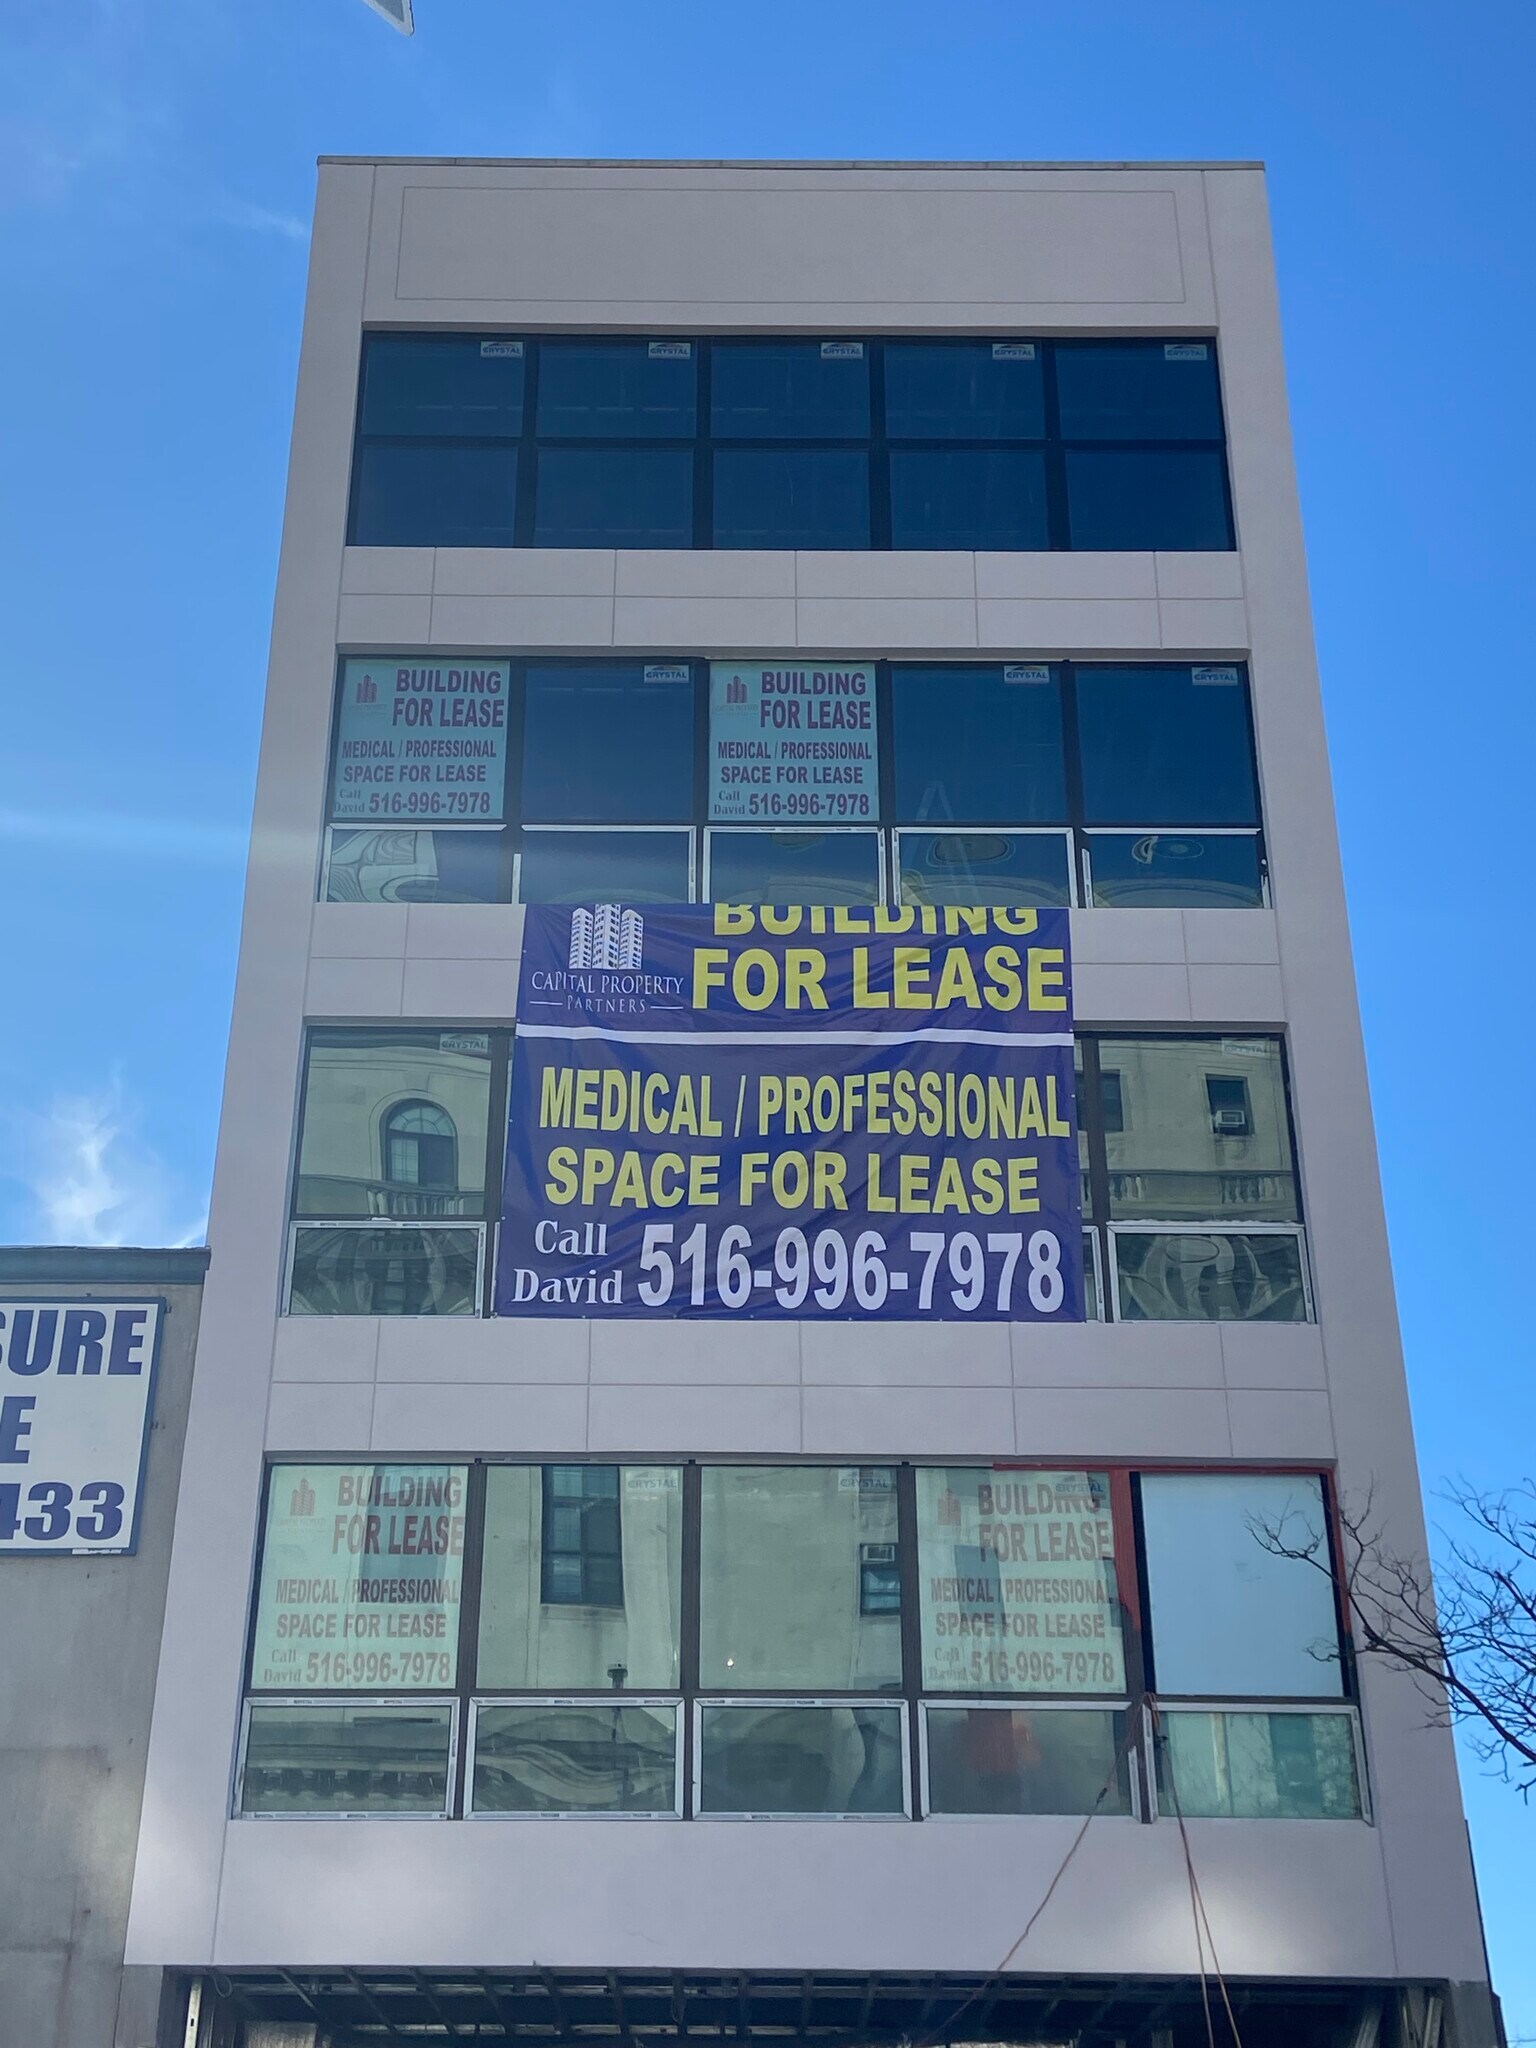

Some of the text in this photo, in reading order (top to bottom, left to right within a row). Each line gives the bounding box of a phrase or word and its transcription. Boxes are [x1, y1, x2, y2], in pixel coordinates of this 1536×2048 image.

[482, 346, 521, 355] CRYSTAL
[649, 347, 689, 356] CRYSTAL
[823, 347, 861, 356] CRYSTAL
[396, 669, 501, 693] BUILDING
[645, 670, 687, 679] CRYSTAL
[761, 671, 866, 695] BUILDING
[1006, 671, 1048, 680] CRYSTAL
[1193, 672, 1237, 681] CRYSTAL
[392, 698, 504, 727] FOR LEASE
[760, 699, 800, 728] FOR
[807, 700, 871, 729] LEASE
[341, 740, 395, 758] MEDICAL
[405, 740, 496, 758] PROFESSIONAL
[718, 741, 771, 759] MEDICAL
[781, 742, 872, 760] PROFESSIONAL
[343, 765, 486, 782] SPACE FOR LEASE
[721, 766, 863, 784] SPACE FOR LEASE
[333, 791, 490, 814] David 516-996-7978
[339, 788, 361, 799] Call
[714, 792, 869, 816] David 516-996-7978
[718, 790, 740, 801] Call
[531, 971, 684, 995] CAPITAL PROPERTY
[692, 945, 1067, 1012] FOR LEASE
[567, 995, 646, 1013] PARTNERS
[441, 1040, 487, 1049] CRYSTAL
[539, 1066, 723, 1137] MEDICAL
[759, 1069, 1071, 1140] PROFESSIONAL
[544, 1146, 1041, 1215] SPACE FOR LEASE
[534, 1220, 609, 1256] Call
[511, 1223, 1064, 1312] David 516-996-7978
[0, 1308, 148, 1376] URE
[337, 1475, 462, 1508] BUILDING
[627, 1479, 678, 1489] CRYSTAL
[332, 1514, 465, 1556] FOR LEASE
[978, 1523, 1029, 1562] FOR
[1034, 1521, 1112, 1562] LEASE
[275, 1578, 339, 1604] MEDICAL
[352, 1578, 460, 1604] PROFESSIONAL
[931, 1578, 994, 1604] MEDICAL
[276, 1613, 447, 1638] SPACE FOR LEASE
[935, 1612, 1106, 1638] SPACE FOR LEASE
[263, 1652, 451, 1683] David 516-996-7978
[271, 1648, 297, 1663] Call
[970, 1651, 1115, 1683] 516-996-7978
